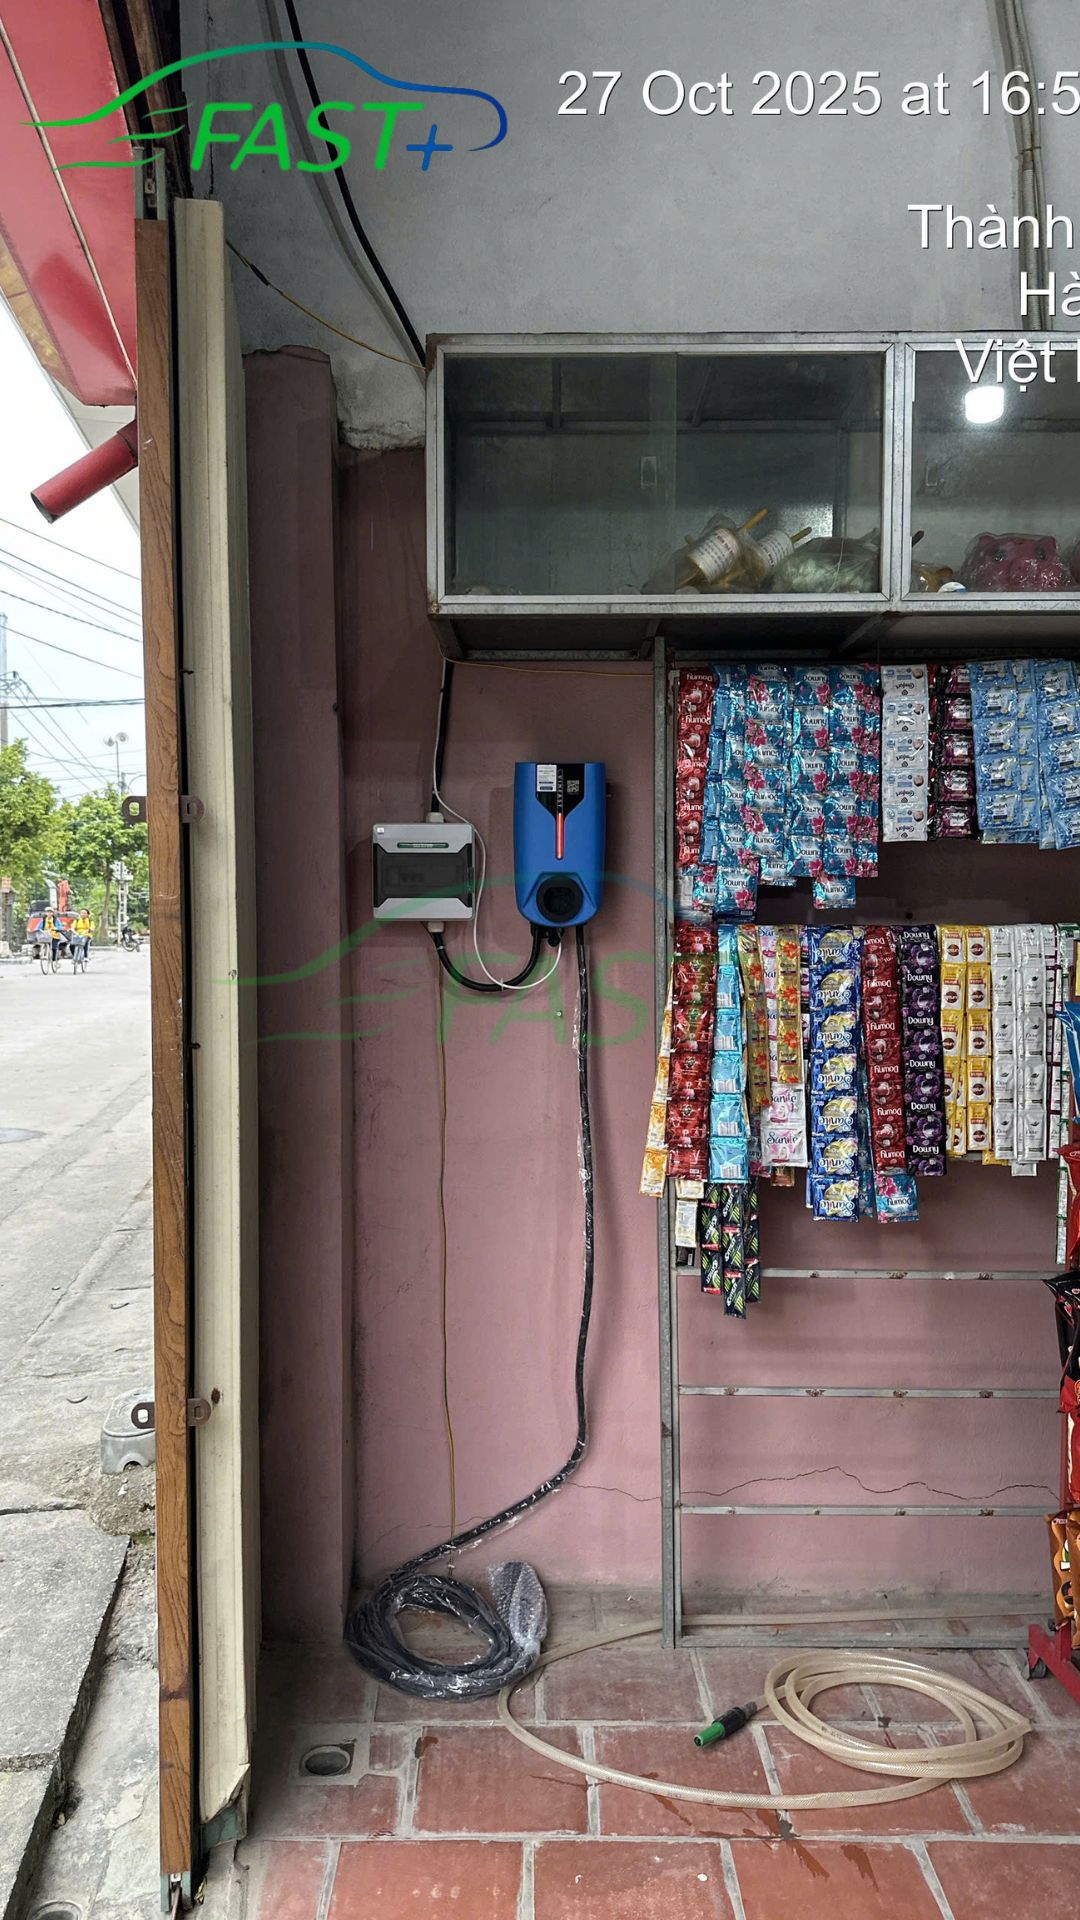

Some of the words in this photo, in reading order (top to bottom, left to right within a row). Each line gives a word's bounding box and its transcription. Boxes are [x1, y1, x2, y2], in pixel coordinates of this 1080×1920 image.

[904, 931, 930, 940] Downy
[907, 973, 933, 983] Downy
[908, 1016, 934, 1025] Downy
[870, 1022, 895, 1030] Downy
[874, 1065, 899, 1073] Downy
[909, 1060, 936, 1069] Downy
[911, 1102, 937, 1111] Downy
[876, 1107, 902, 1116] Downy
[880, 1149, 905, 1158] Downy
[912, 1144, 939, 1154] Downy
[887, 1197, 912, 1206] Downy
